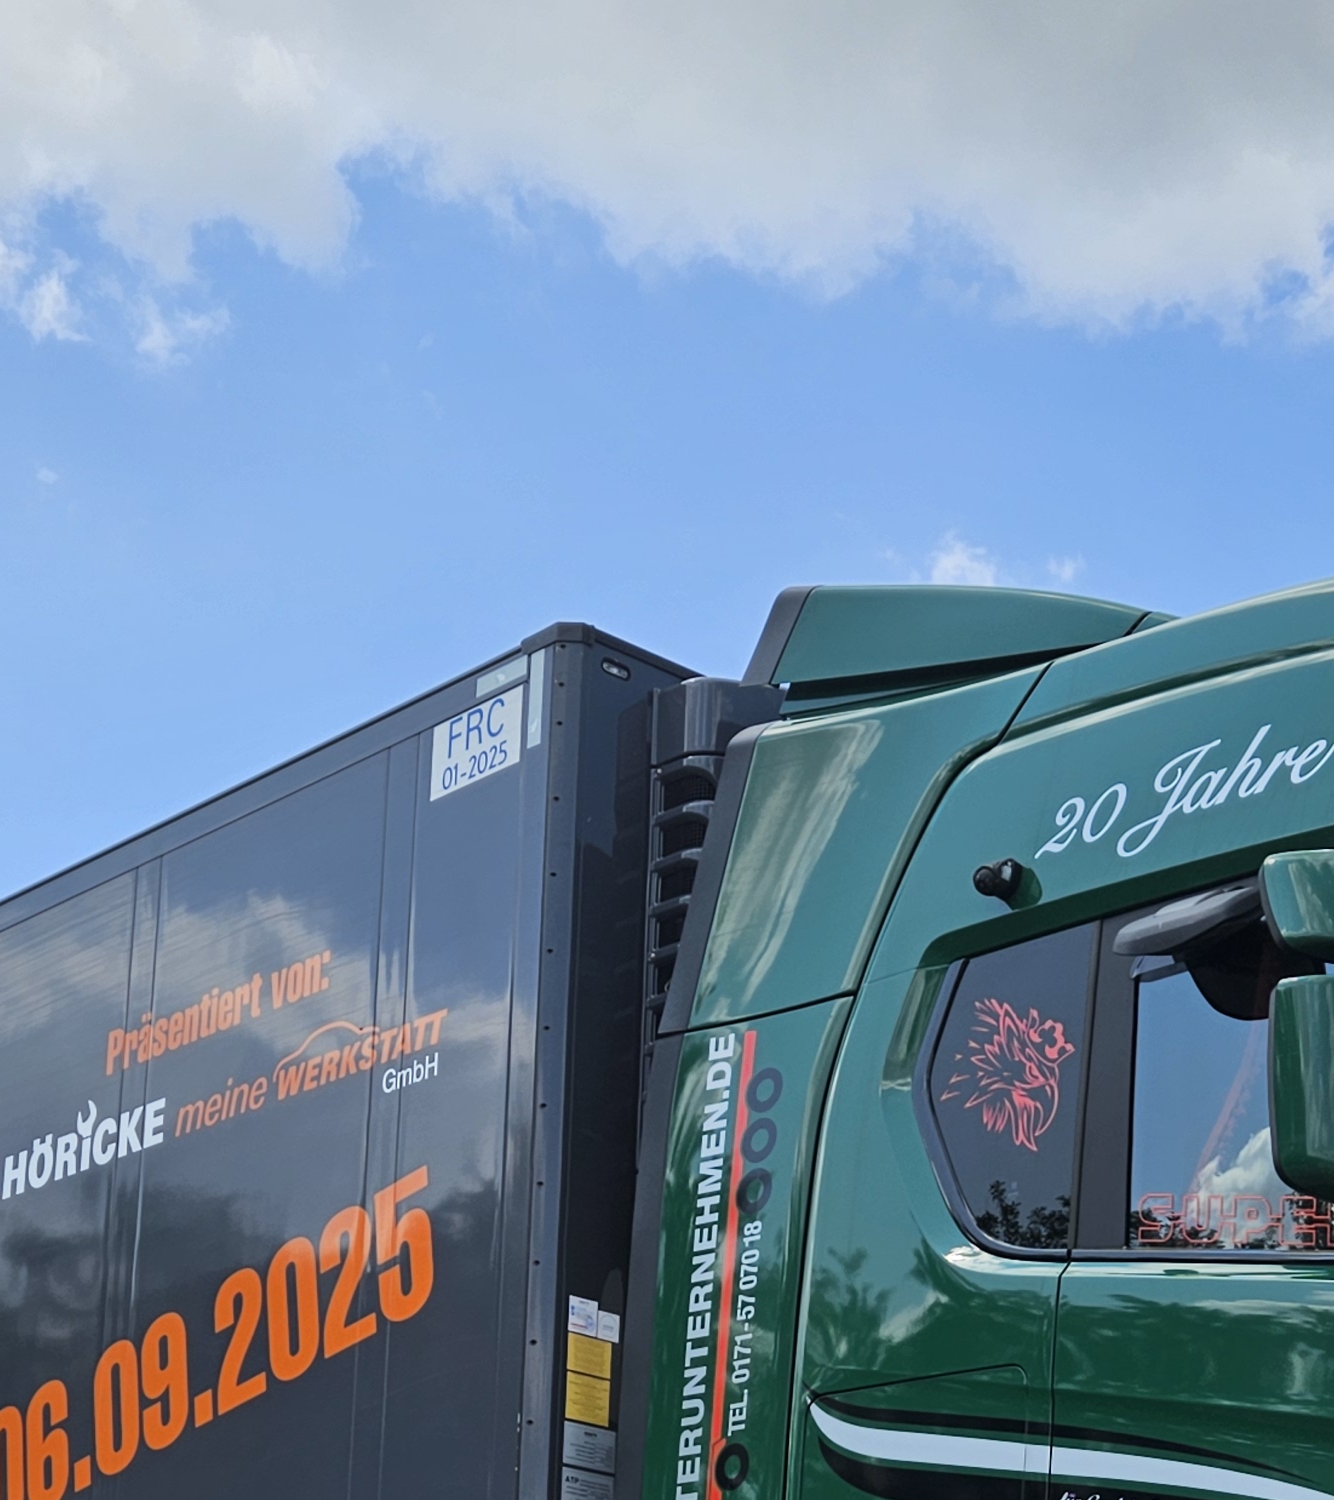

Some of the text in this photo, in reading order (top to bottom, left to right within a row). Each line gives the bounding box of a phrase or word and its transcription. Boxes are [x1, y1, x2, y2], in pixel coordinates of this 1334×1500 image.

[447, 698, 505, 759] FRC
[442, 740, 508, 791] 01-2025
[1034, 783, 1128, 860] 20
[104, 950, 332, 1077] Präsentiert von:
[174, 1075, 269, 1138] meine
[276, 1009, 449, 1100] WERKSTATT
[381, 1053, 439, 1094] GmbH
